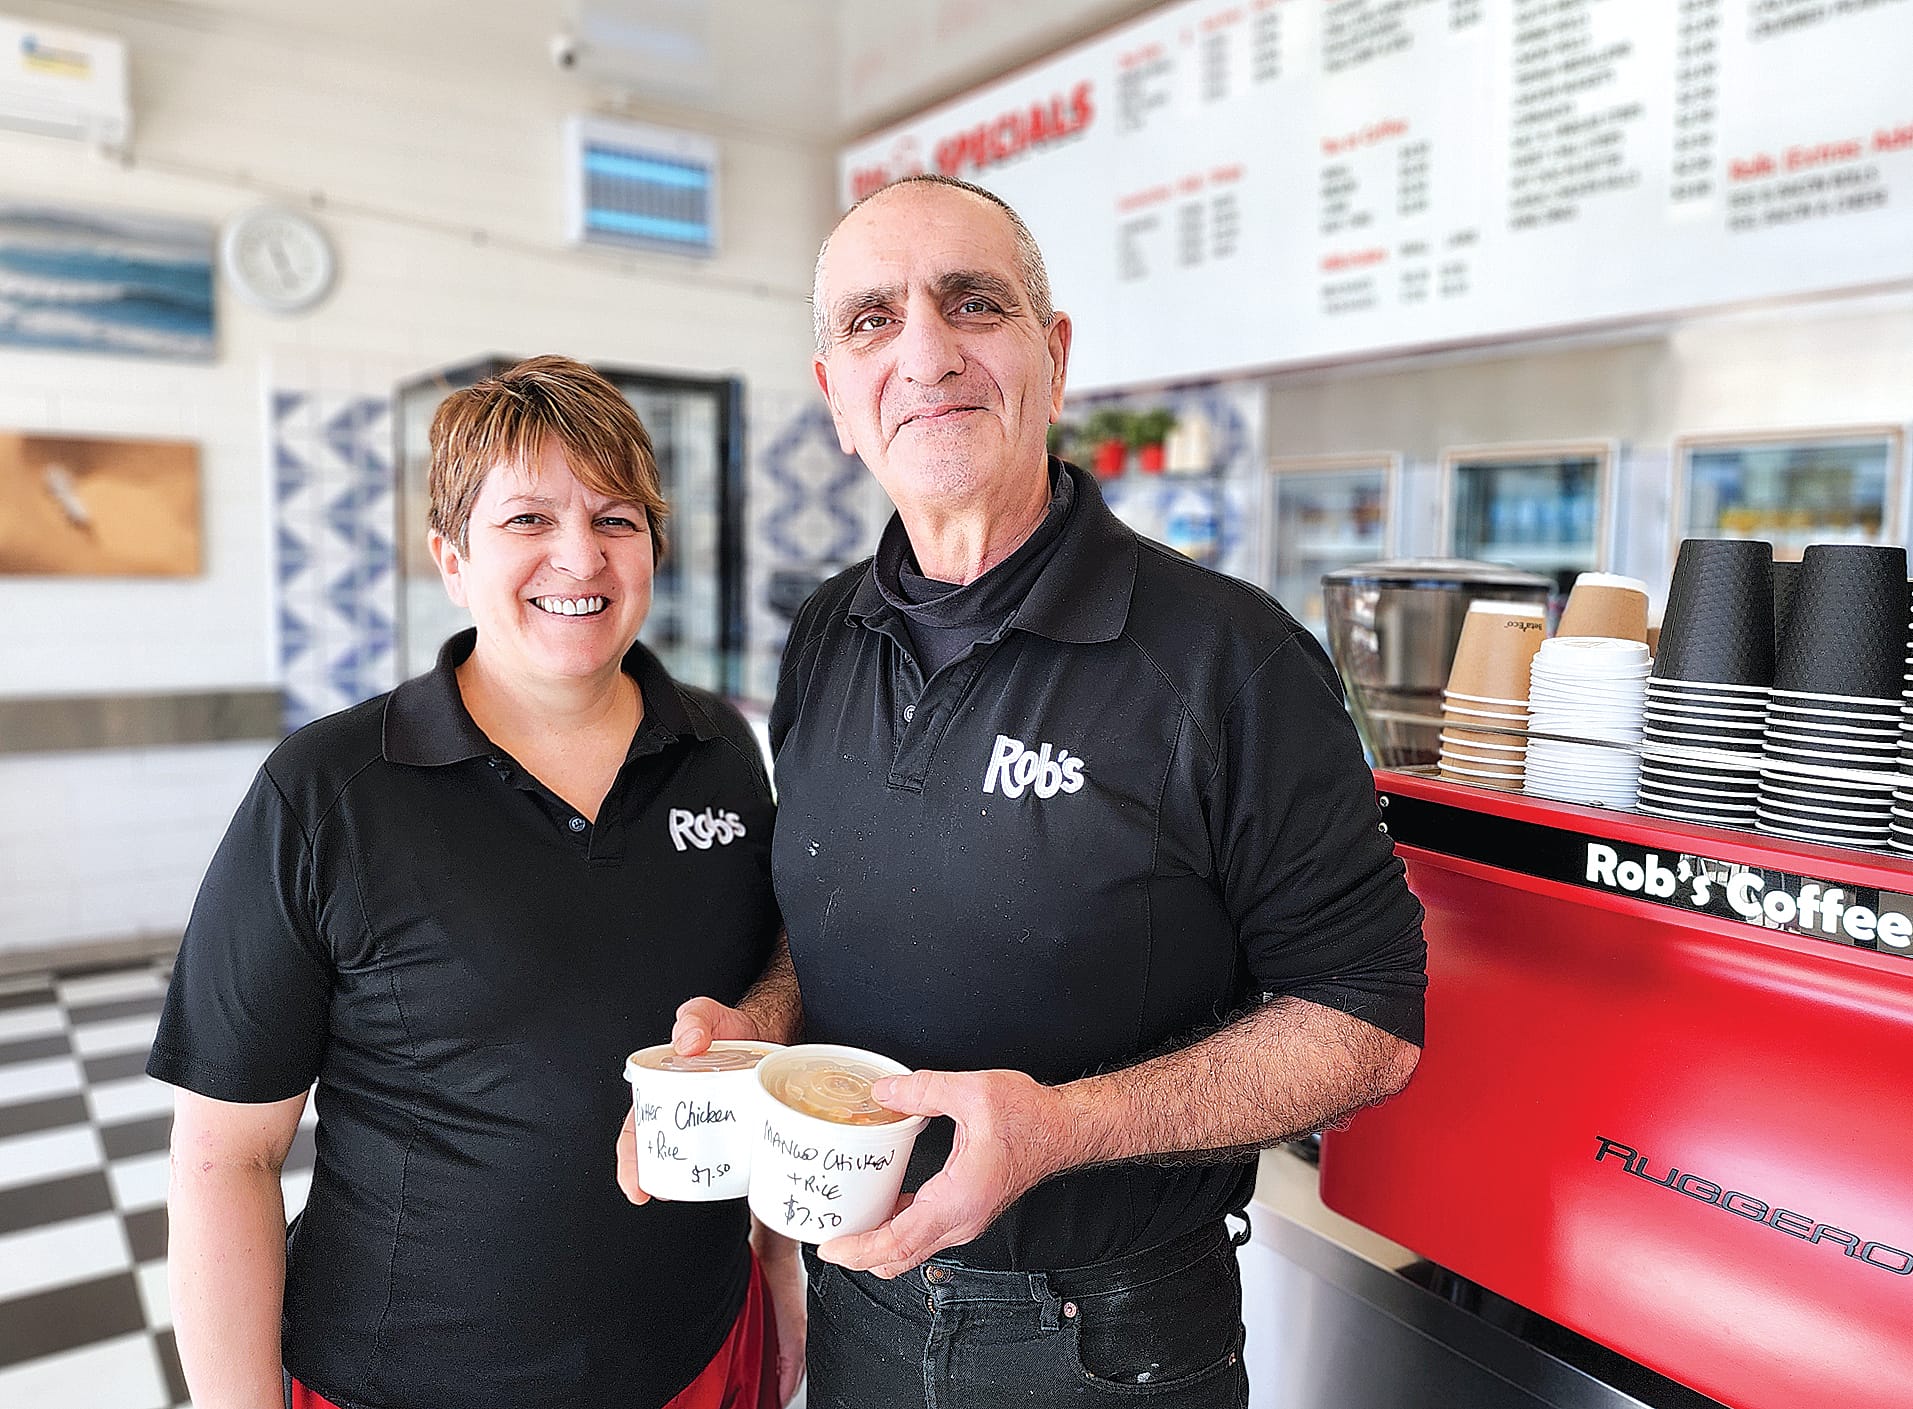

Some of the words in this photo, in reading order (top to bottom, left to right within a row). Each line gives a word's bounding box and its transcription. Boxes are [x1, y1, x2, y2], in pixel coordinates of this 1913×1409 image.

[982, 735, 1085, 799] Rob's
[669, 807, 746, 852] Rob's
[1586, 842, 1712, 906] Rob's
[1726, 871, 1913, 948] Coffee
[675, 1101, 736, 1130] Chicken
[657, 1131, 688, 1160] Rice
[764, 1120, 819, 1160] MANGO
[692, 1164, 731, 1187] $7.50
[783, 1194, 842, 1229] $7.50
[1595, 1135, 1913, 1275] RUGGERO
